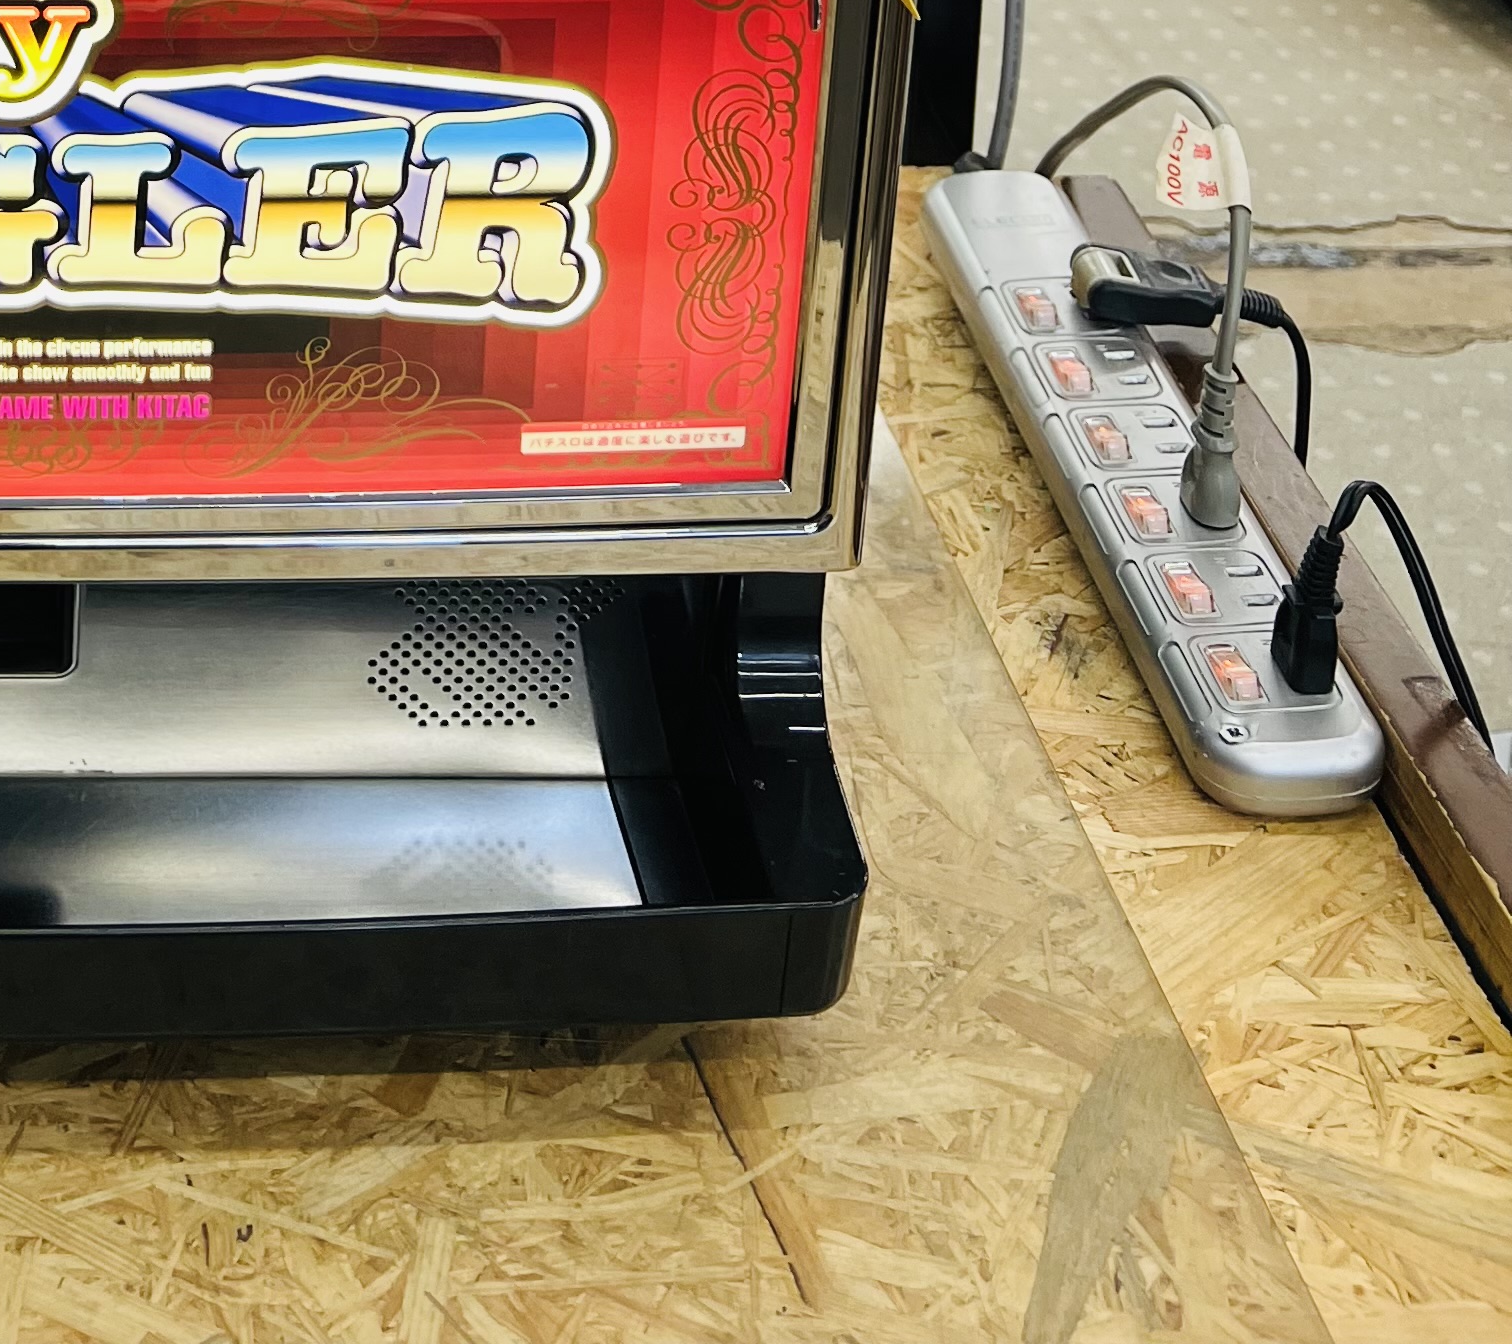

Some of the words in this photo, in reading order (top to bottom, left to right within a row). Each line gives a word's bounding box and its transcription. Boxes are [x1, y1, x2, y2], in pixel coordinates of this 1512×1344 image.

[1166, 119, 1189, 207] AC100V
[16, 338, 44, 357] the
[45, 338, 101, 357] circus
[104, 338, 214, 359] performance
[21, 363, 69, 382] show
[71, 363, 147, 384] smoothly
[149, 363, 181, 382] and
[184, 363, 213, 382] fun
[62, 394, 130, 421] WITH
[136, 394, 211, 421] KITAC
